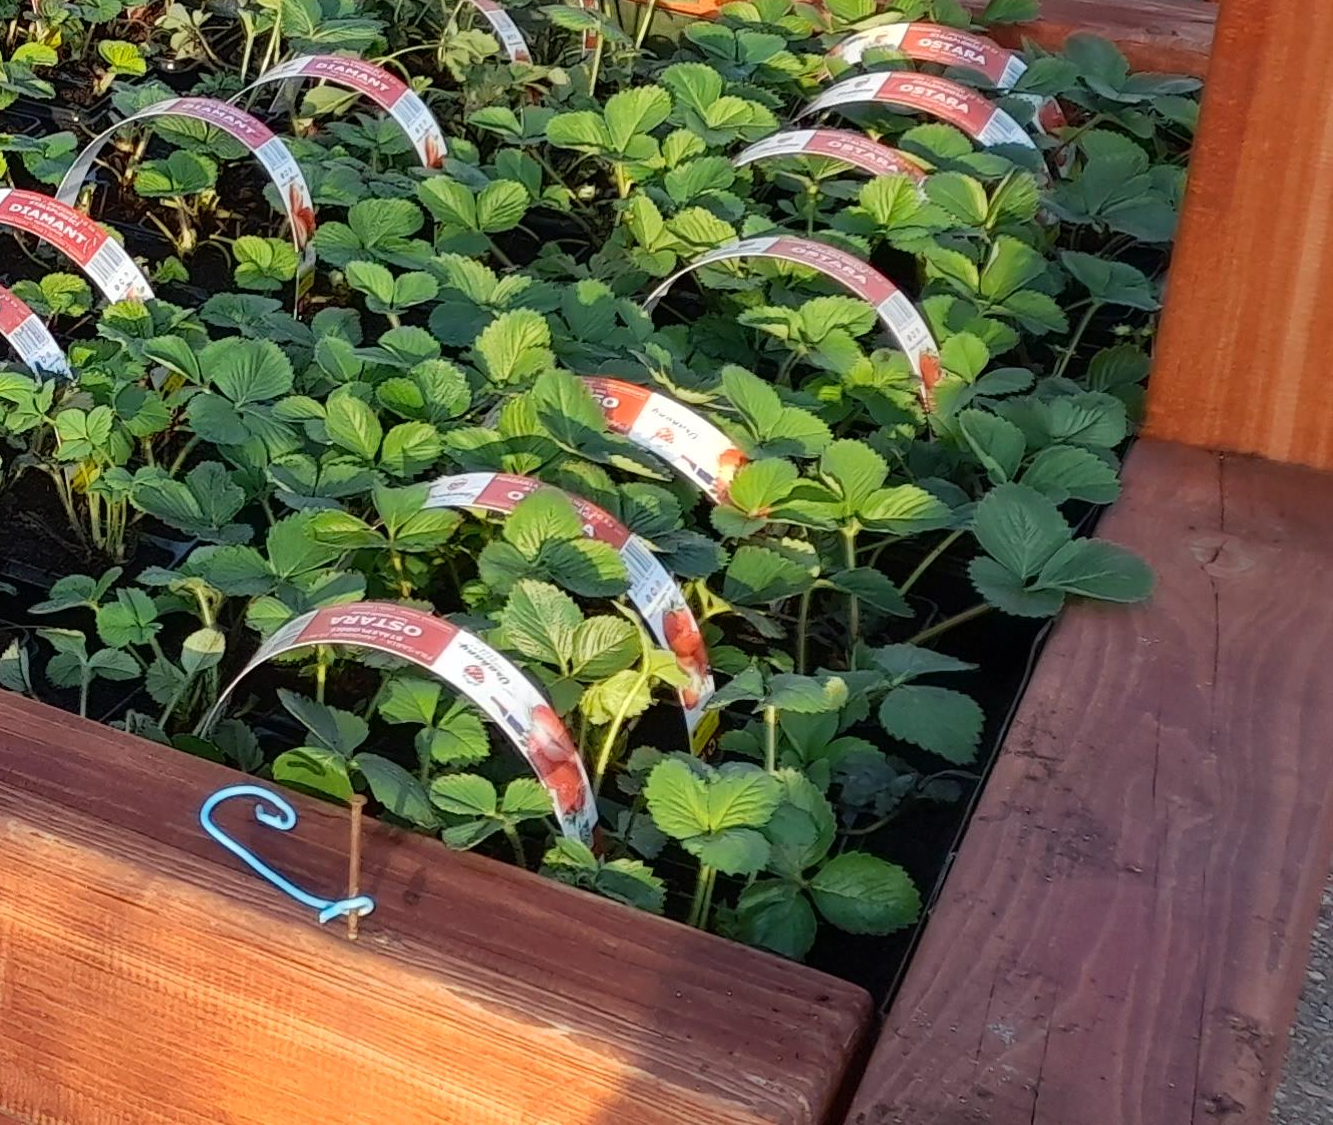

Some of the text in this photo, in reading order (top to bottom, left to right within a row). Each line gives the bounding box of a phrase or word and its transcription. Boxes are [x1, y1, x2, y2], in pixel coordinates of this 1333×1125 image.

[918, 37, 986, 66] OSTARA
[315, 60, 390, 92] DIAMANT
[899, 82, 969, 114] OSTARA
[828, 140, 899, 173] OSTARA
[8, 203, 87, 243] DIAMANT
[793, 245, 867, 286] OSTARA
[329, 613, 423, 638] OSTARA
